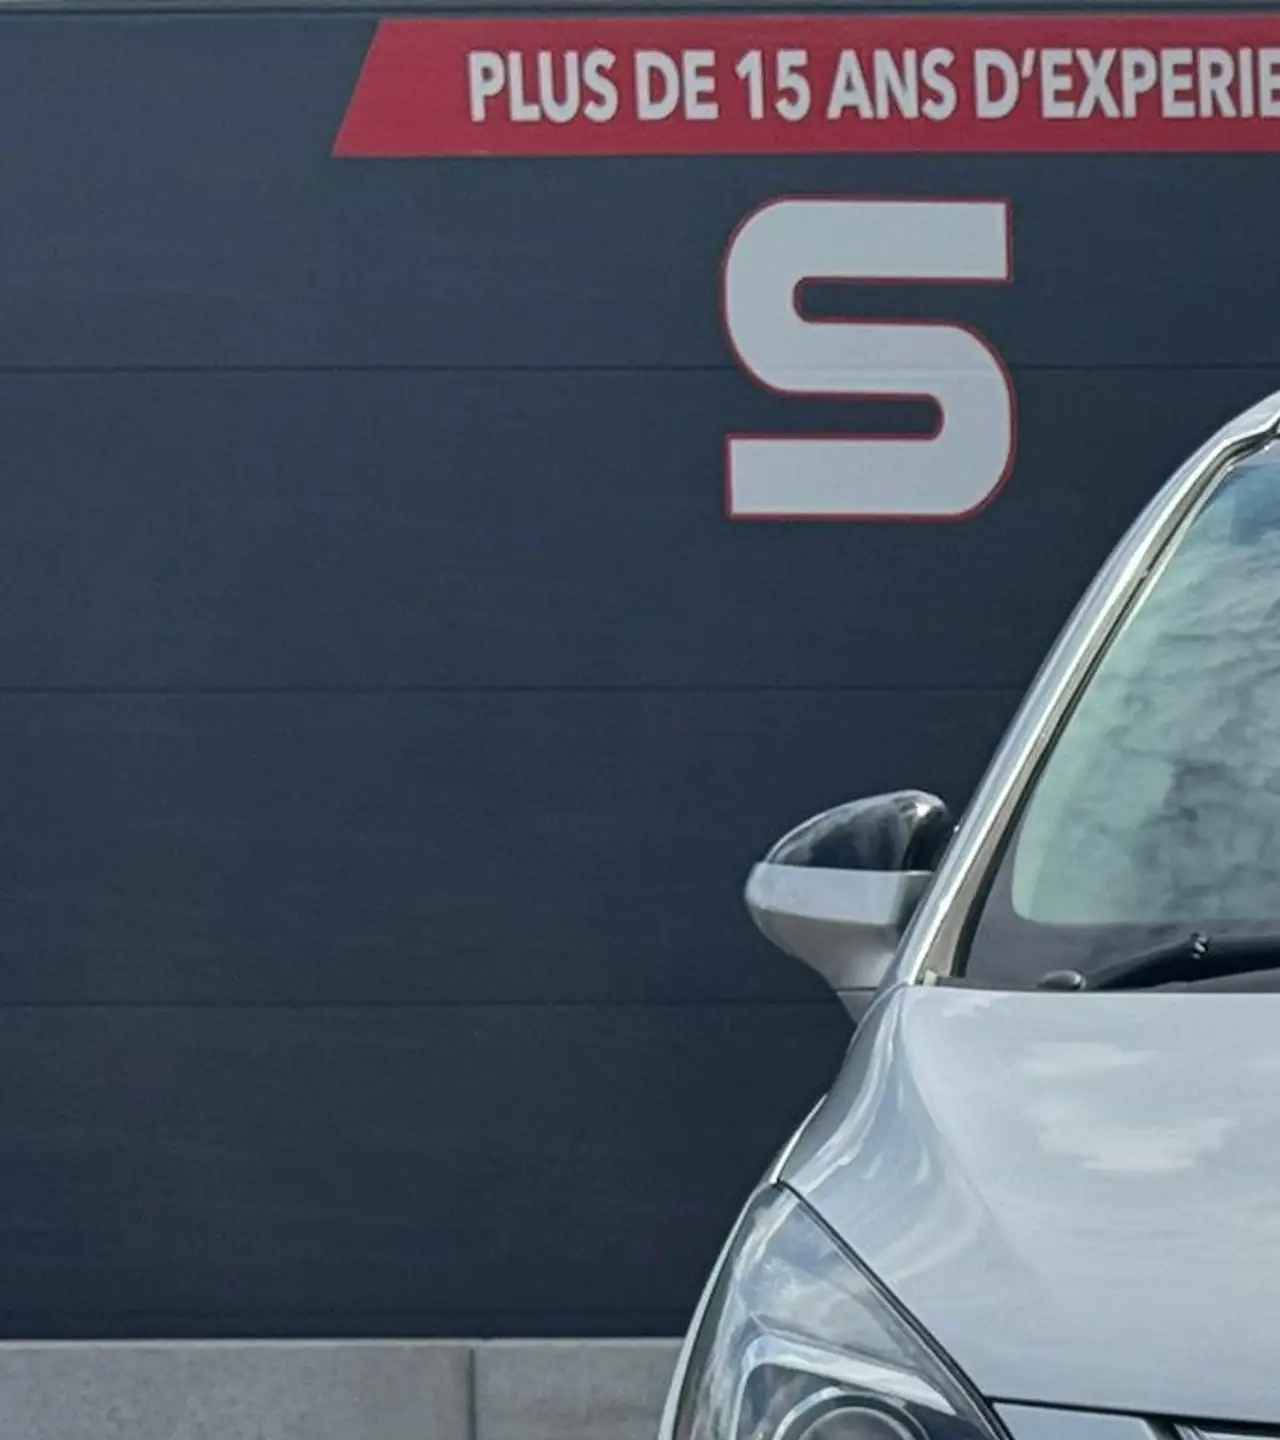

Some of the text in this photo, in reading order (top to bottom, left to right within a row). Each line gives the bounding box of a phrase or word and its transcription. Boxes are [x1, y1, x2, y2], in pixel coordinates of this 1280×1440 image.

[468, 48, 618, 123] PLUS
[634, 49, 719, 121] DE
[735, 48, 811, 121] 15
[827, 47, 957, 121] ANS
